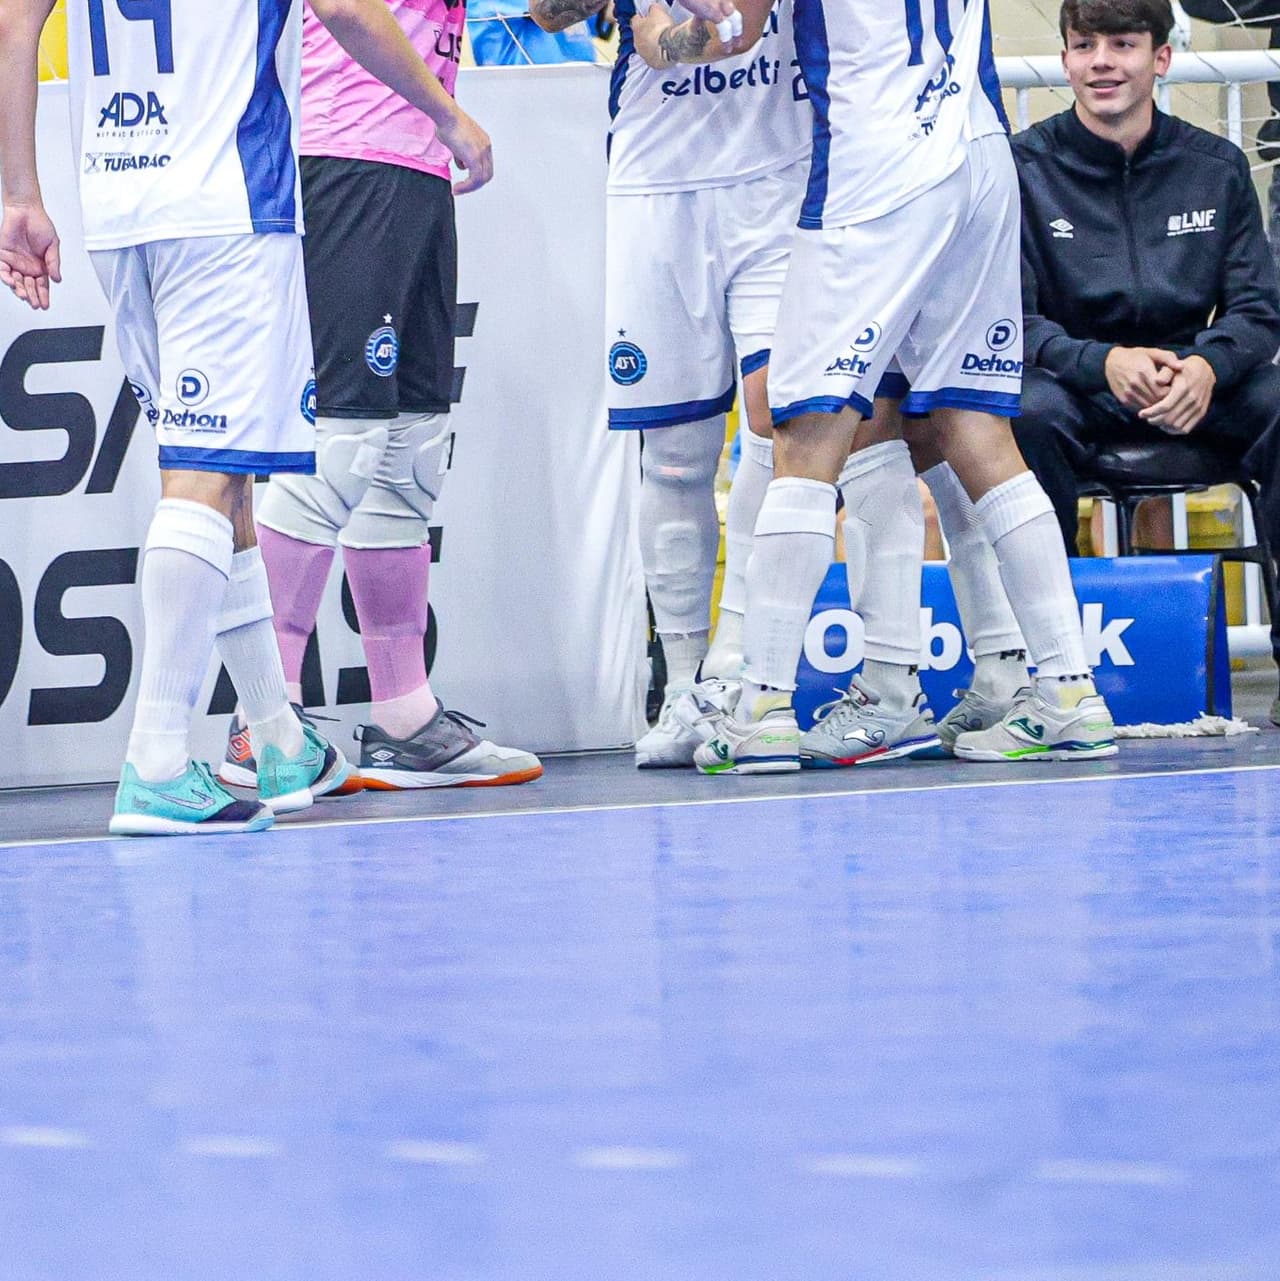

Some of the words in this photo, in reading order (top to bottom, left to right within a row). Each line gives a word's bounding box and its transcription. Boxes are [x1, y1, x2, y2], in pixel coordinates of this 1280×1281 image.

[98, 91, 169, 128] ADA
[1181, 209, 1216, 229] LNF
[162, 408, 228, 429] Dehon
